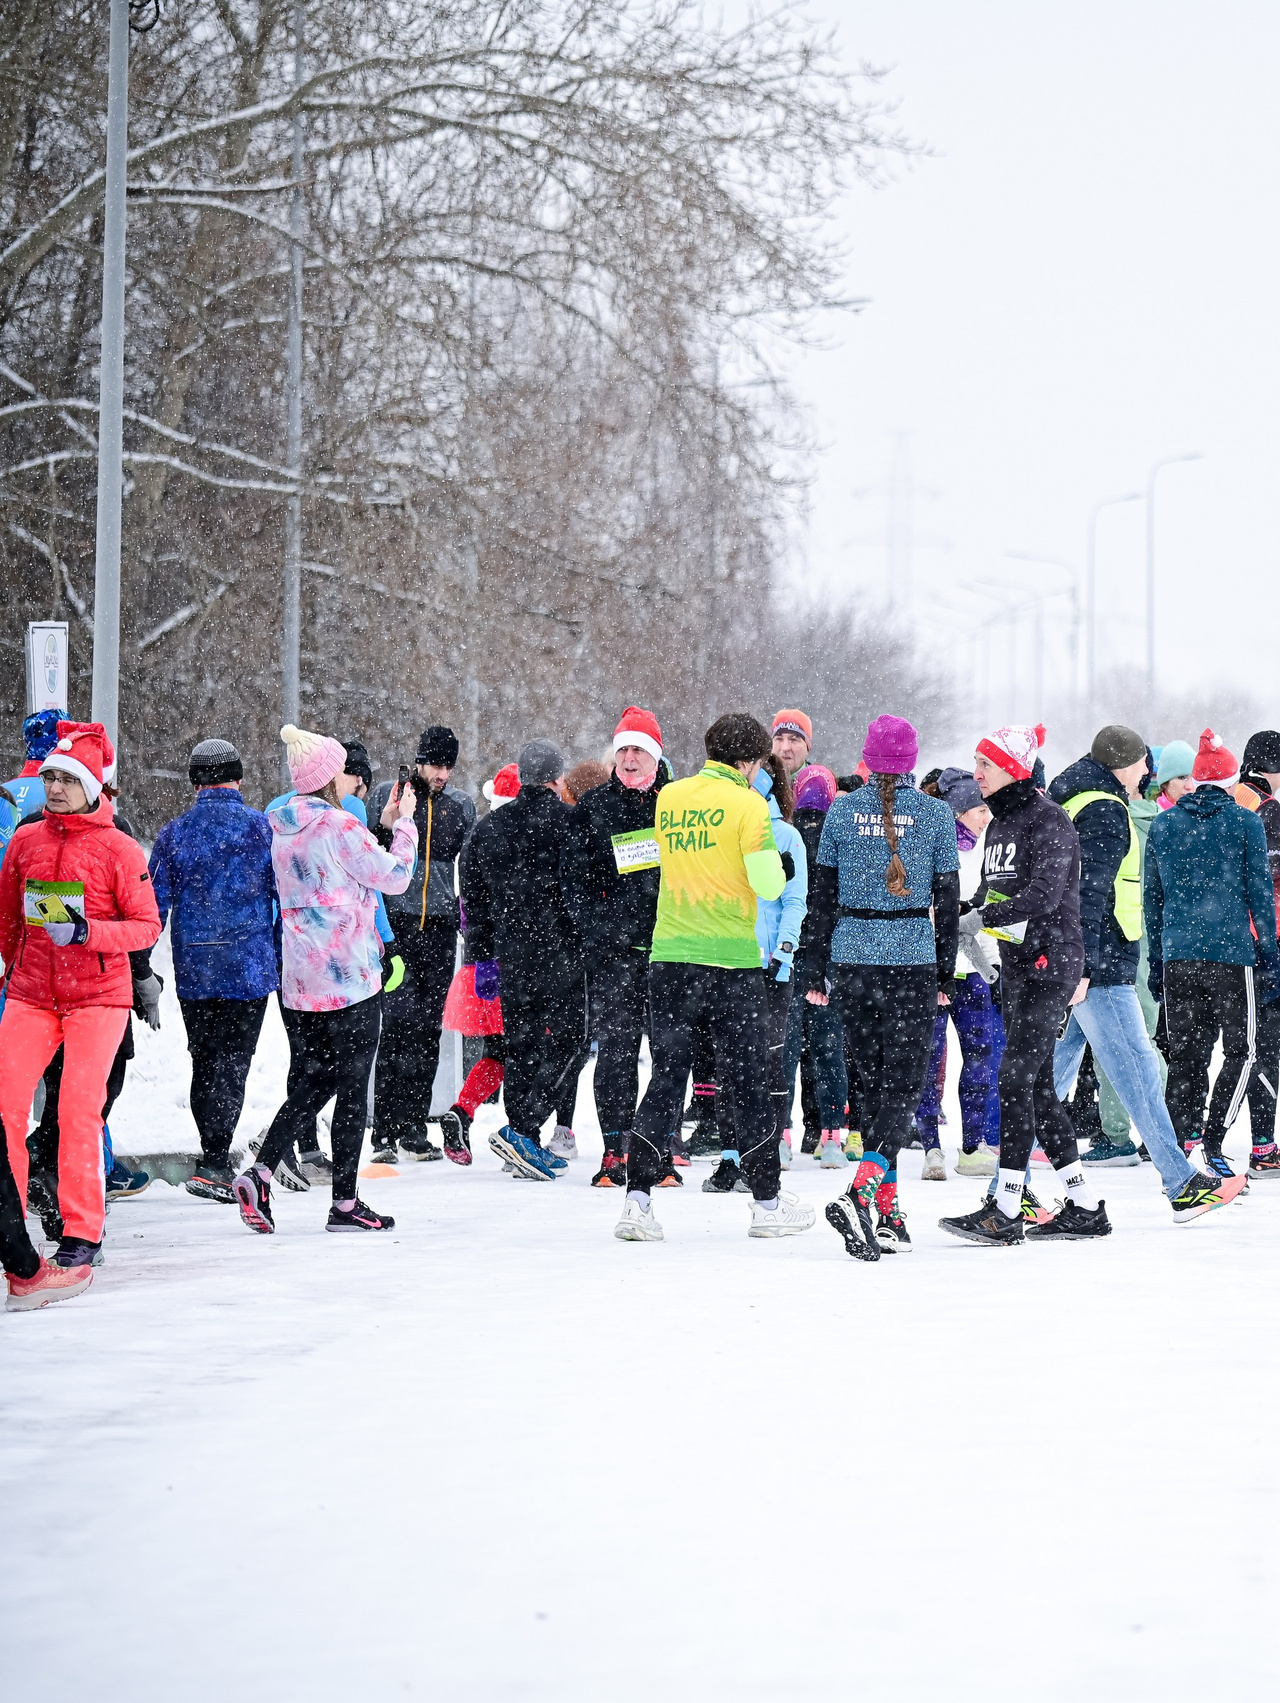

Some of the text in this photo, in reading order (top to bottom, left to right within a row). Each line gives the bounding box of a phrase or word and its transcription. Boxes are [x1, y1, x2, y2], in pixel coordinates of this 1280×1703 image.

[660, 808, 725, 832] BLIZKO
[870, 813, 915, 826] БЕИШЬ
[664, 829, 717, 854] TRAIL
